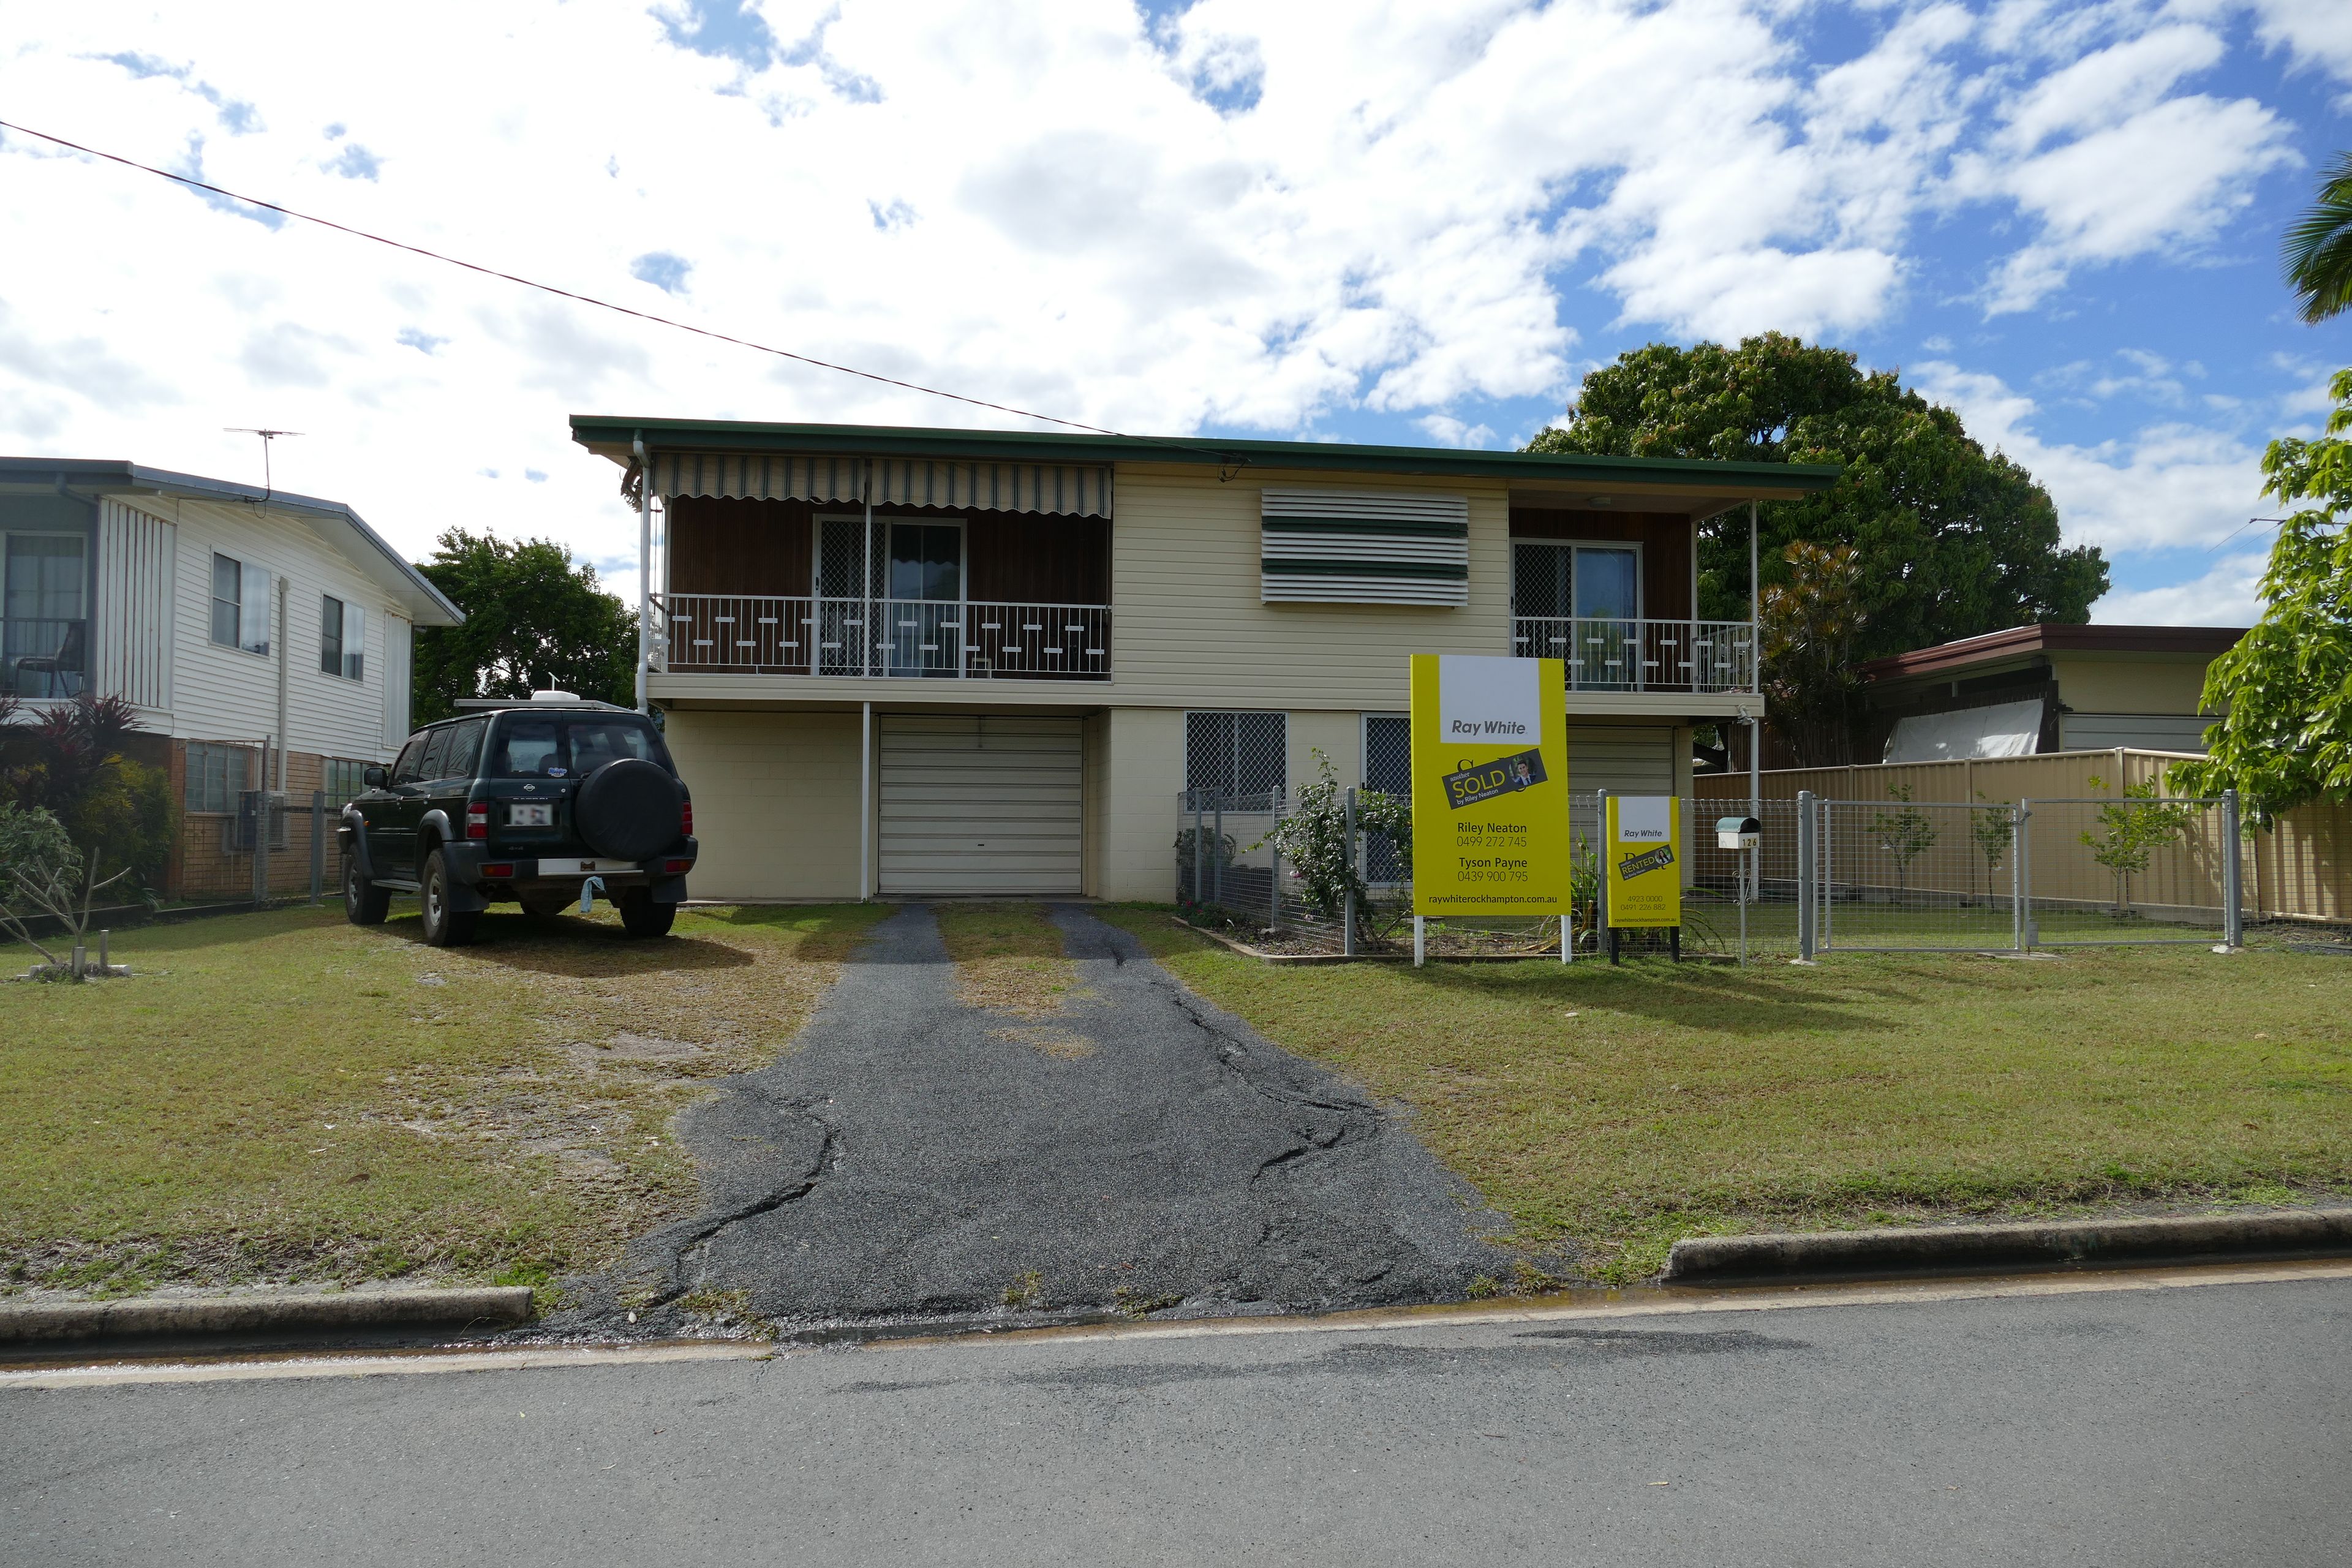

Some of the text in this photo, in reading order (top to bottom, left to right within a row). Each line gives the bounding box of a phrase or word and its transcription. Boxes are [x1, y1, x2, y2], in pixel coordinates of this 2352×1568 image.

[1451, 720, 1526, 736] Ray White
[1450, 771, 1471, 782] another
[1452, 770, 1506, 799] SOLD
[1464, 794, 1478, 803] Riley
[1478, 788, 1499, 798] Neaton
[1458, 822, 1527, 835] Riley Neaton
[1624, 829, 1640, 839] Ray
[1457, 836, 1527, 847] 0499 272 745
[1743, 838, 1757, 846] 126
[1459, 858, 1528, 870] Tyson Payne
[1622, 856, 1655, 875] RENTED
[1458, 871, 1528, 882] 0439 900 795
[1429, 895, 1557, 905] raywhiterockhampton.com.au
